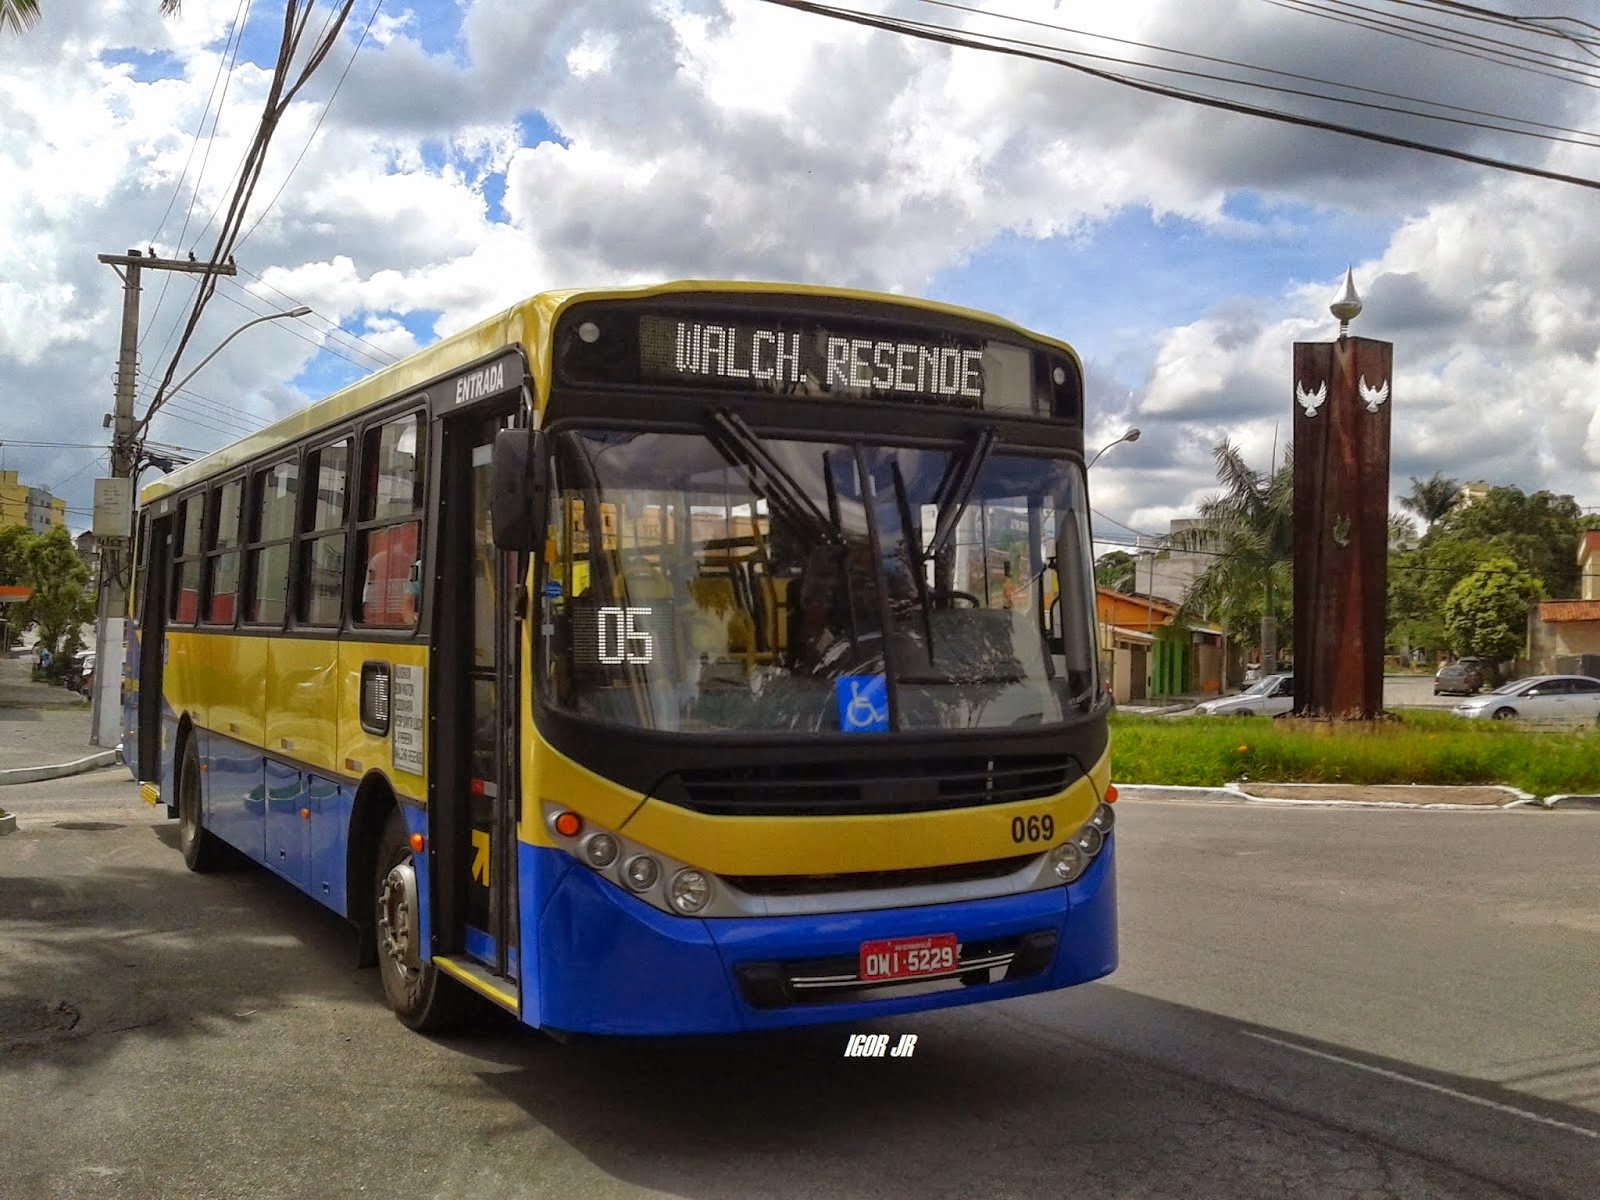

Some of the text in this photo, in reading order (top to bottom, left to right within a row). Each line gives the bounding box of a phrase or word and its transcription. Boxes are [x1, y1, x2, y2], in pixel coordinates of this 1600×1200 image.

[455, 362, 504, 404] ENTRADA
[676, 322, 983, 397] WALCH. RESENDE
[598, 607, 653, 664] 05
[1011, 814, 1054, 844] 069
